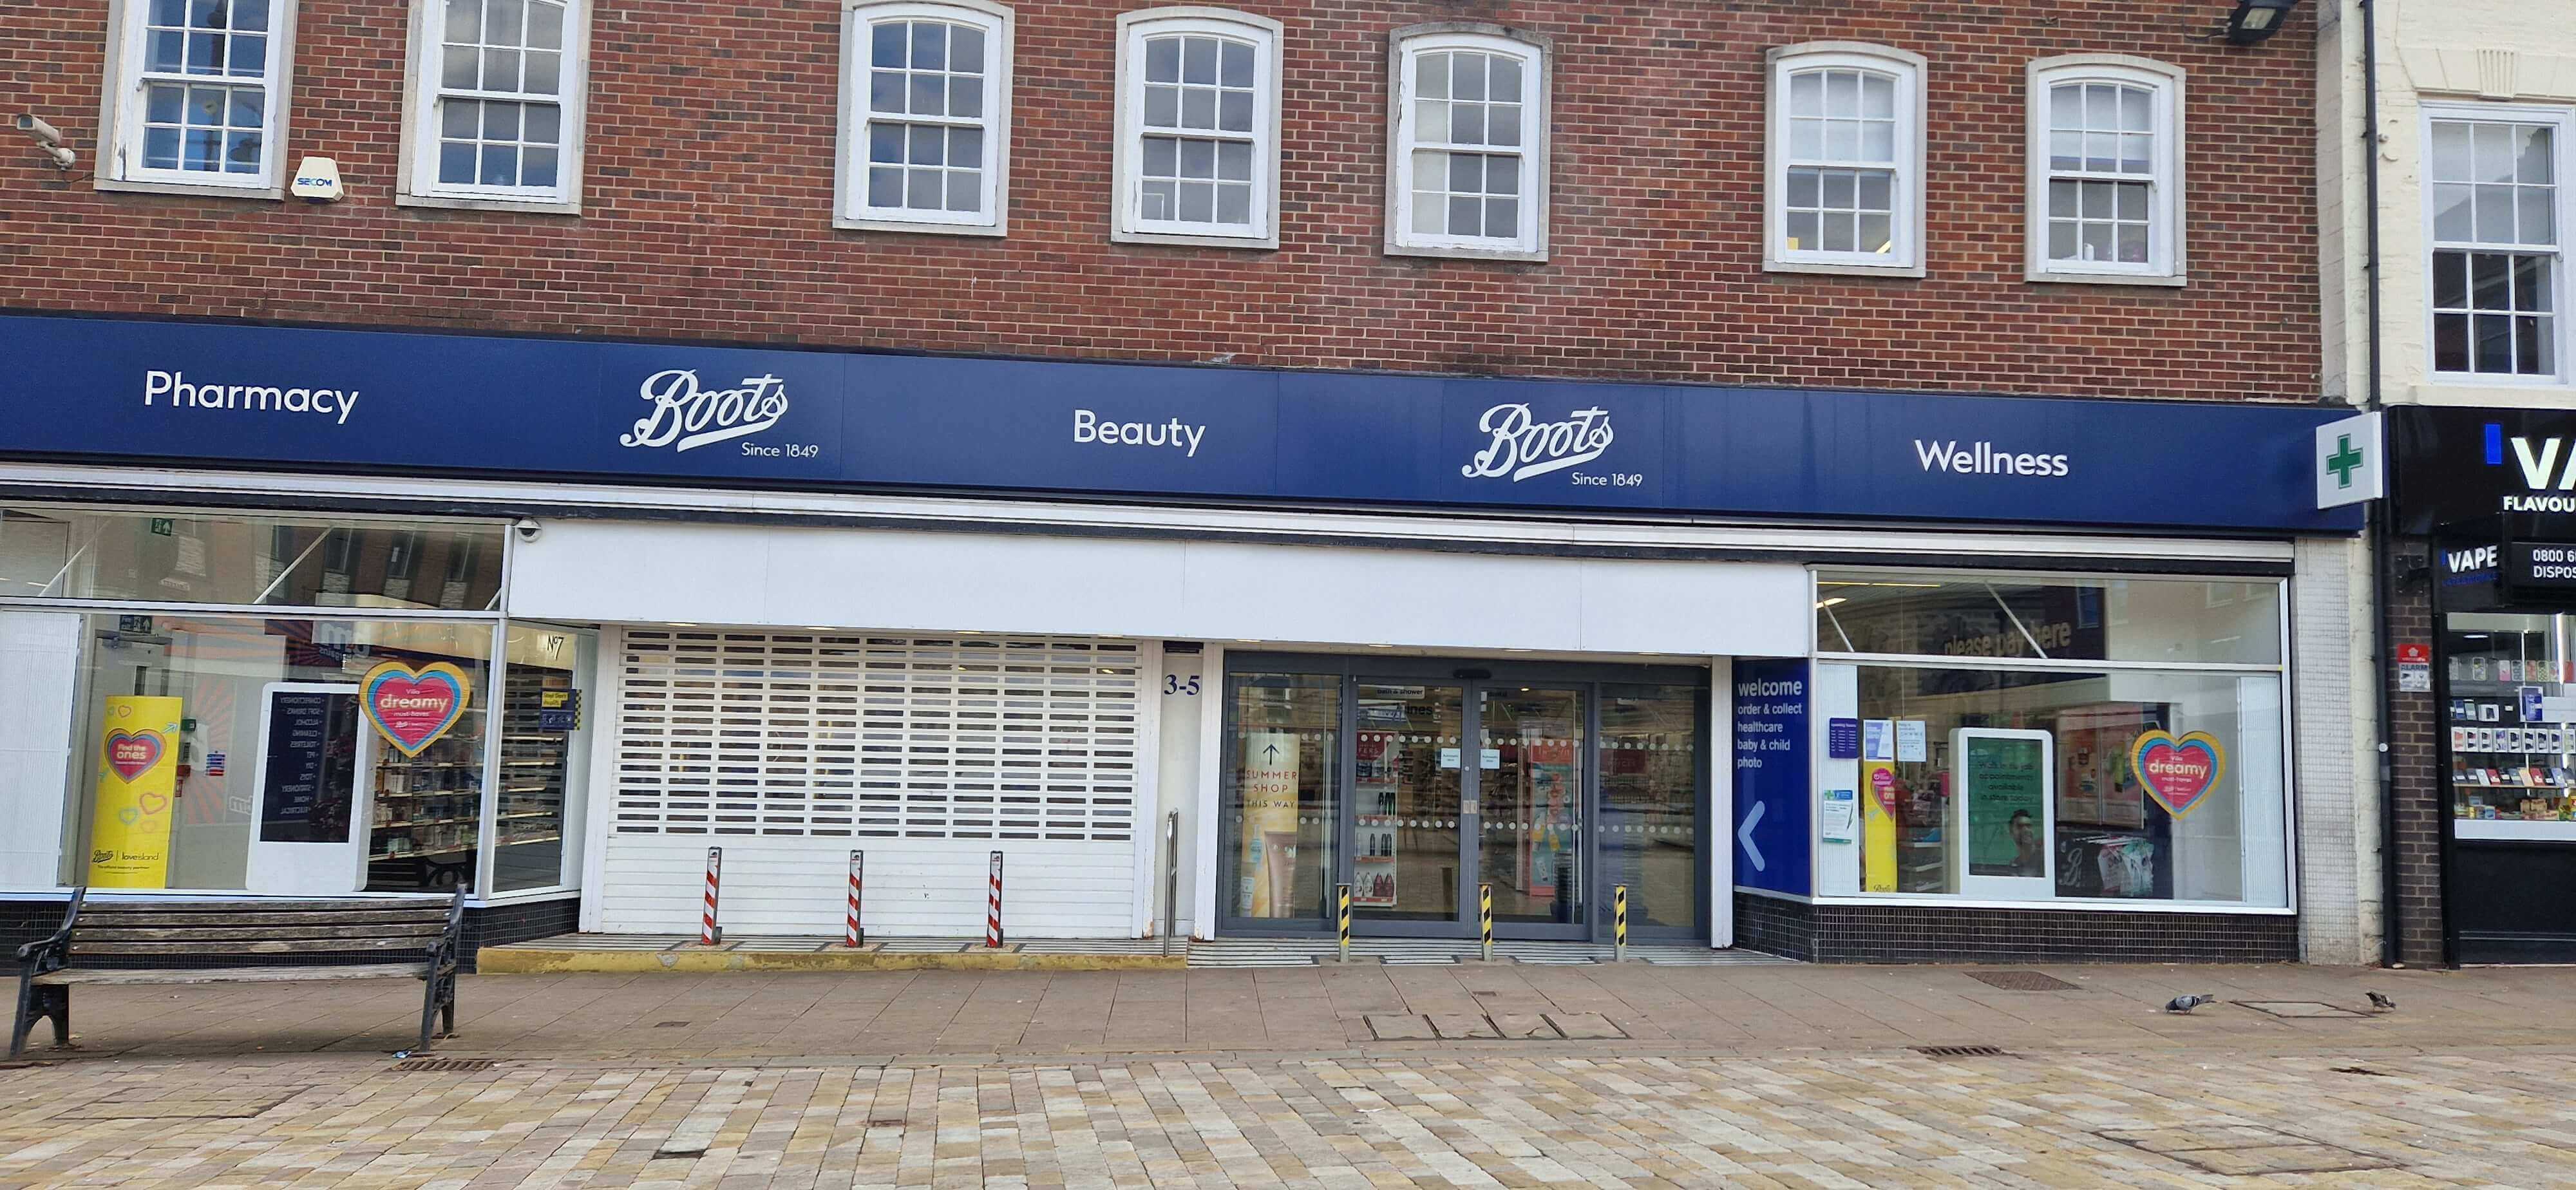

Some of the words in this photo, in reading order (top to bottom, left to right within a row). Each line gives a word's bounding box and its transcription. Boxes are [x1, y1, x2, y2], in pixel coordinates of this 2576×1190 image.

[298, 178, 332, 187] SECOM
[144, 370, 359, 424] Pharmacy
[620, 369, 788, 453] Boots
[1074, 409, 1206, 457] Beauty
[741, 442, 780, 457] Since
[785, 444, 819, 458] 1849
[1462, 402, 1614, 483] Boots
[1915, 439, 2069, 477] Wellness
[1571, 472, 1607, 486] Since
[1611, 473, 1643, 487] 1849
[2503, 496, 2576, 513] FLAVOU
[2448, 545, 2497, 573] VAPE
[2533, 549, 2563, 562] 0800
[1945, 634, 1991, 656] please
[2030, 621, 2072, 650] here
[1164, 674, 1200, 695] 3-5
[1738, 678, 1803, 696] welcome
[380, 694, 448, 713] dreamy
[1738, 703, 1761, 715] order
[1763, 703, 1770, 714] &
[1772, 703, 1803, 714] collect
[1738, 721, 1783, 733] healthcare
[1737, 739, 1759, 752] baby
[1760, 739, 1767, 750] &
[1768, 739, 1790, 751] child
[117, 751, 147, 760] ones
[1737, 756, 1763, 769] photo
[1246, 770, 1298, 780] SUMMER
[2148, 759, 2207, 779] dreamy
[1253, 783, 1289, 793] SHOP
[1247, 800, 1268, 808] THIS
